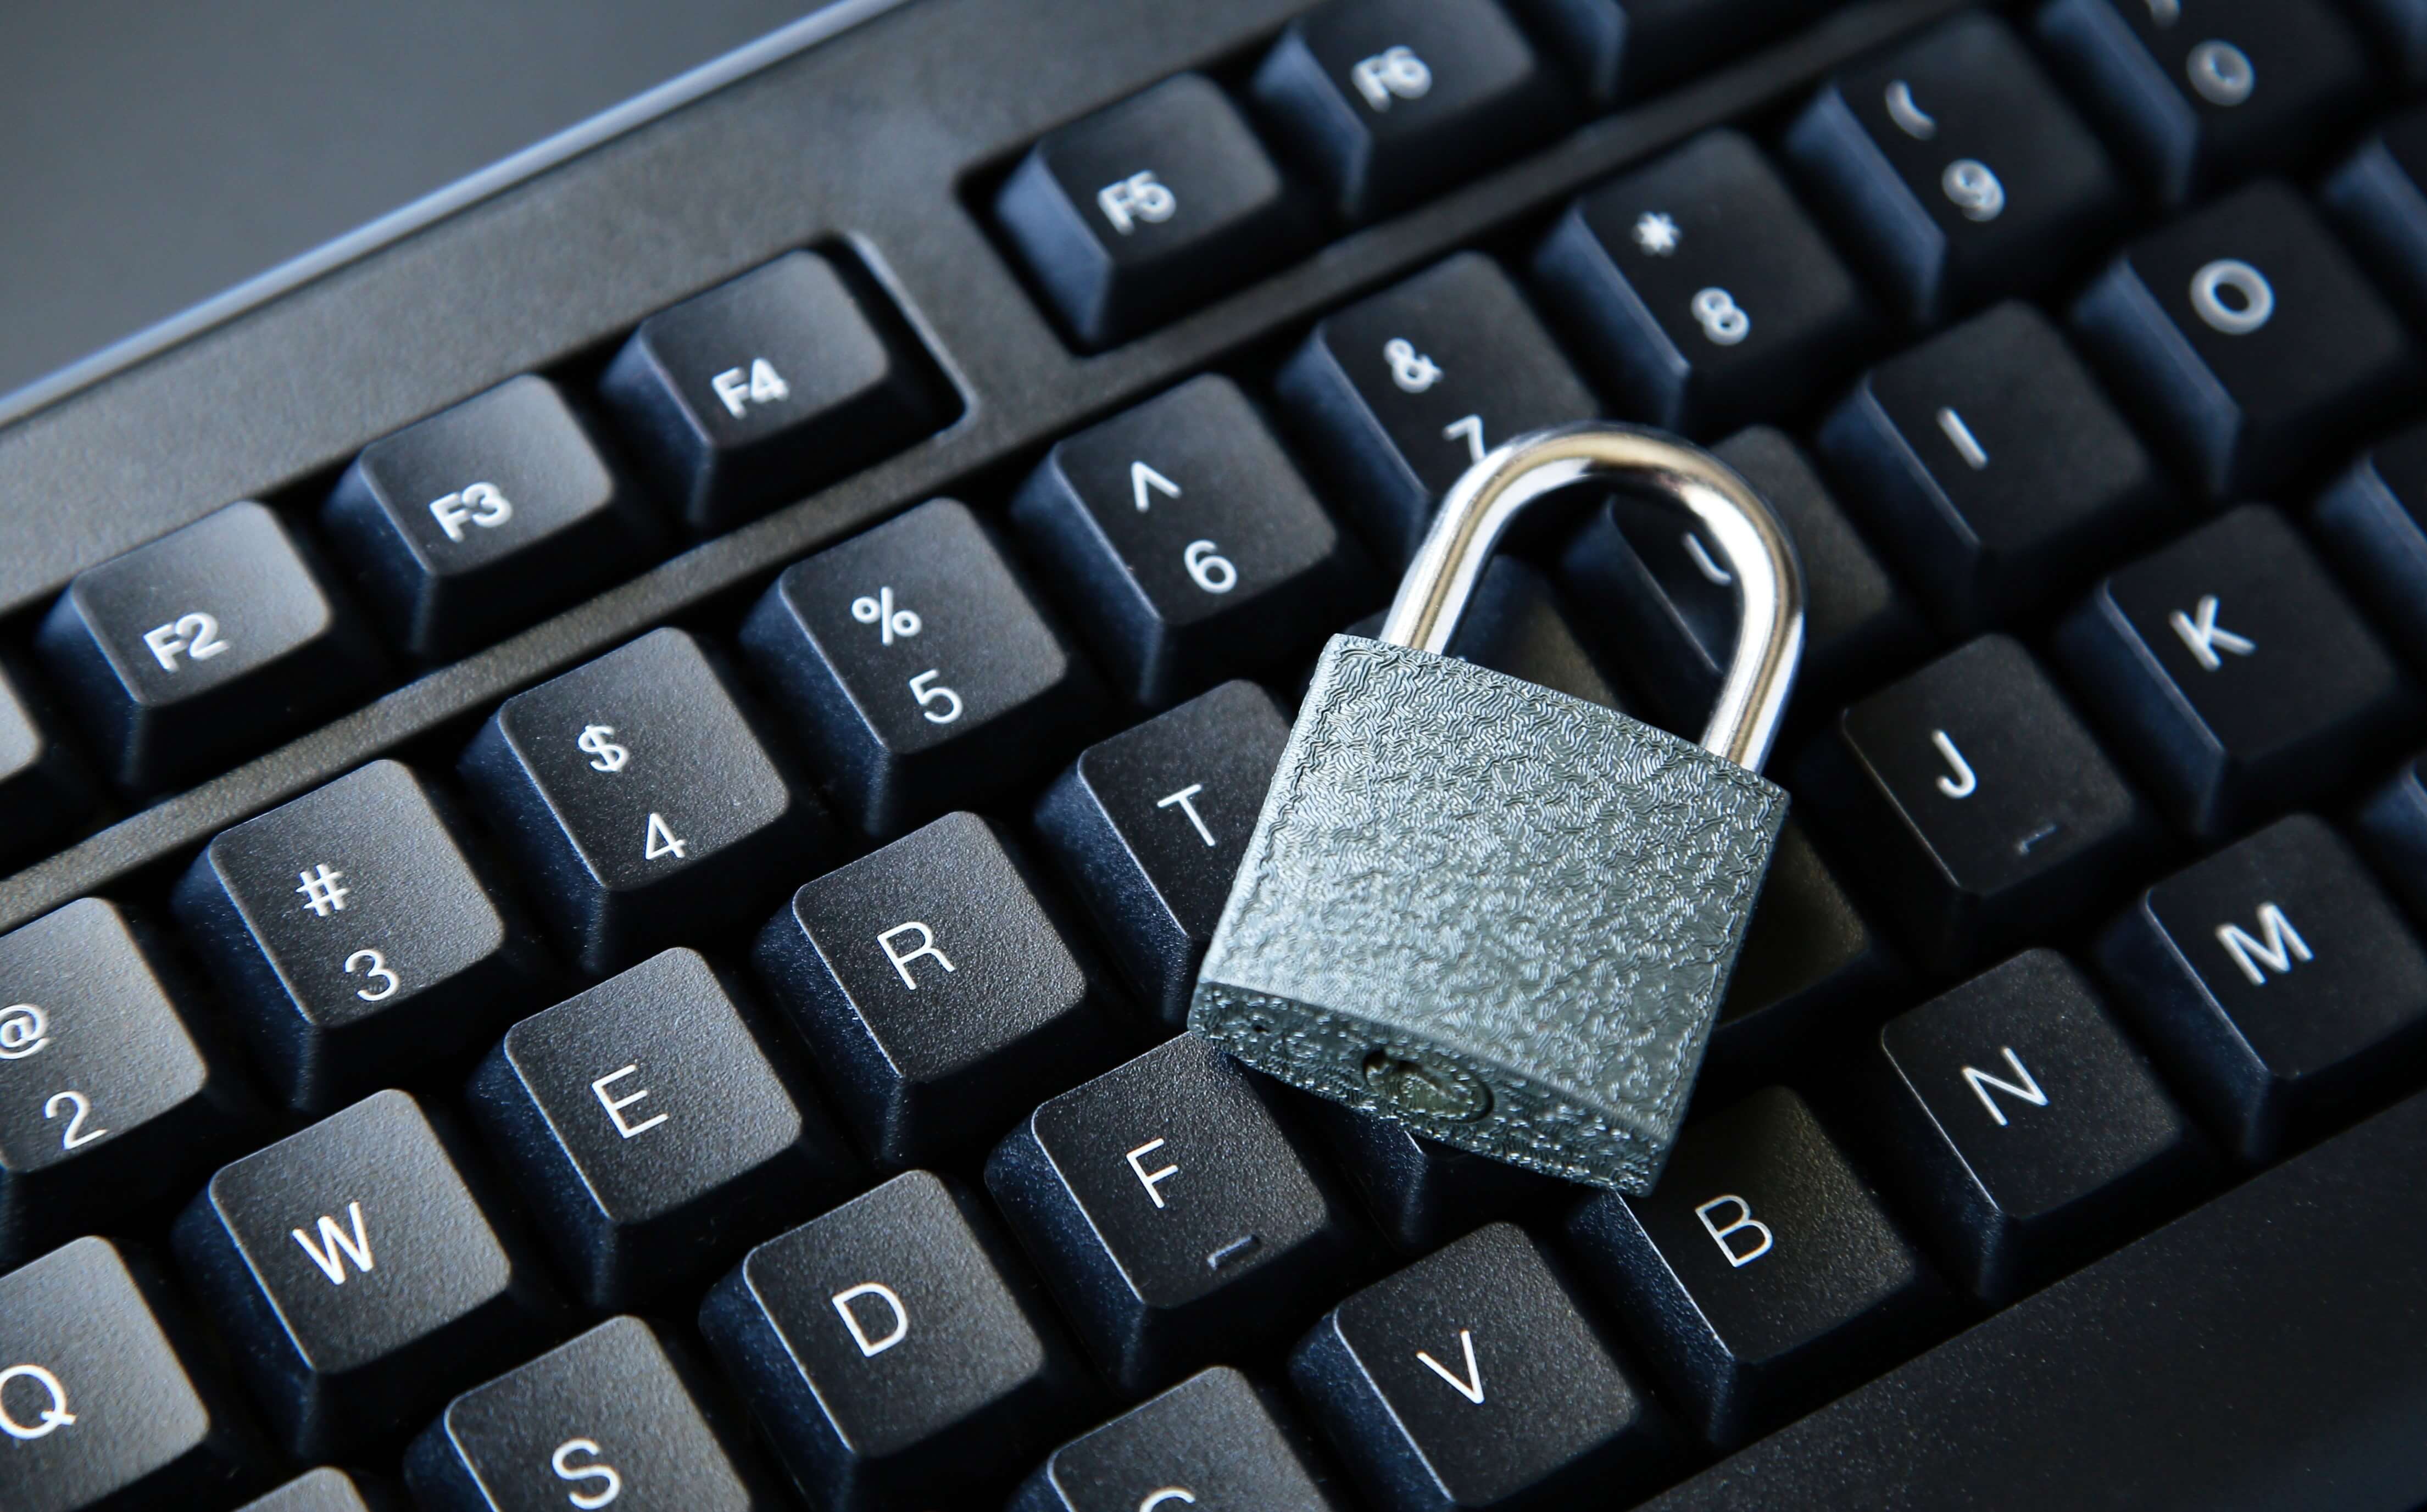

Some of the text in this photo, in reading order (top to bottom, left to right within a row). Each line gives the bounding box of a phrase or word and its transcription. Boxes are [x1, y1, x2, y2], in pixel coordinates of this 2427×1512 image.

[1351, 44, 1432, 112] F6
[2187, 40, 2255, 105] 0
[1099, 171, 1176, 233] F5
[1942, 159, 2005, 221] 9
[1691, 287, 1749, 344] 8
[2190, 259, 2274, 335] O
[712, 358, 789, 419] F4
[1383, 337, 1444, 393] &
[1443, 414, 1485, 462] 7
[1937, 407, 1988, 470] I
[429, 481, 513, 540] F3
[1184, 539, 1237, 593] 6
[143, 611, 230, 671] F2
[851, 586, 922, 645] %
[2173, 597, 2253, 667] K
[909, 668, 963, 724] 5
[577, 723, 630, 773] $
[1934, 730, 1977, 798] J
[644, 812, 686, 861] 4
[1156, 783, 1216, 847] T
[295, 863, 349, 917] #
[344, 948, 400, 1002] 3
[876, 920, 957, 991] R
[2217, 903, 2313, 984] M
[0, 1003, 50, 1060] @
[591, 1064, 669, 1139] E
[1962, 1047, 2049, 1126] N
[44, 1090, 108, 1150] 2
[1125, 1137, 1179, 1209] F
[292, 1201, 374, 1285] W
[1695, 1195, 1773, 1268] B
[831, 1282, 909, 1358] D
[1416, 1329, 1485, 1404] V
[0, 1364, 77, 1440] Q
[552, 1438, 621, 1510] S
